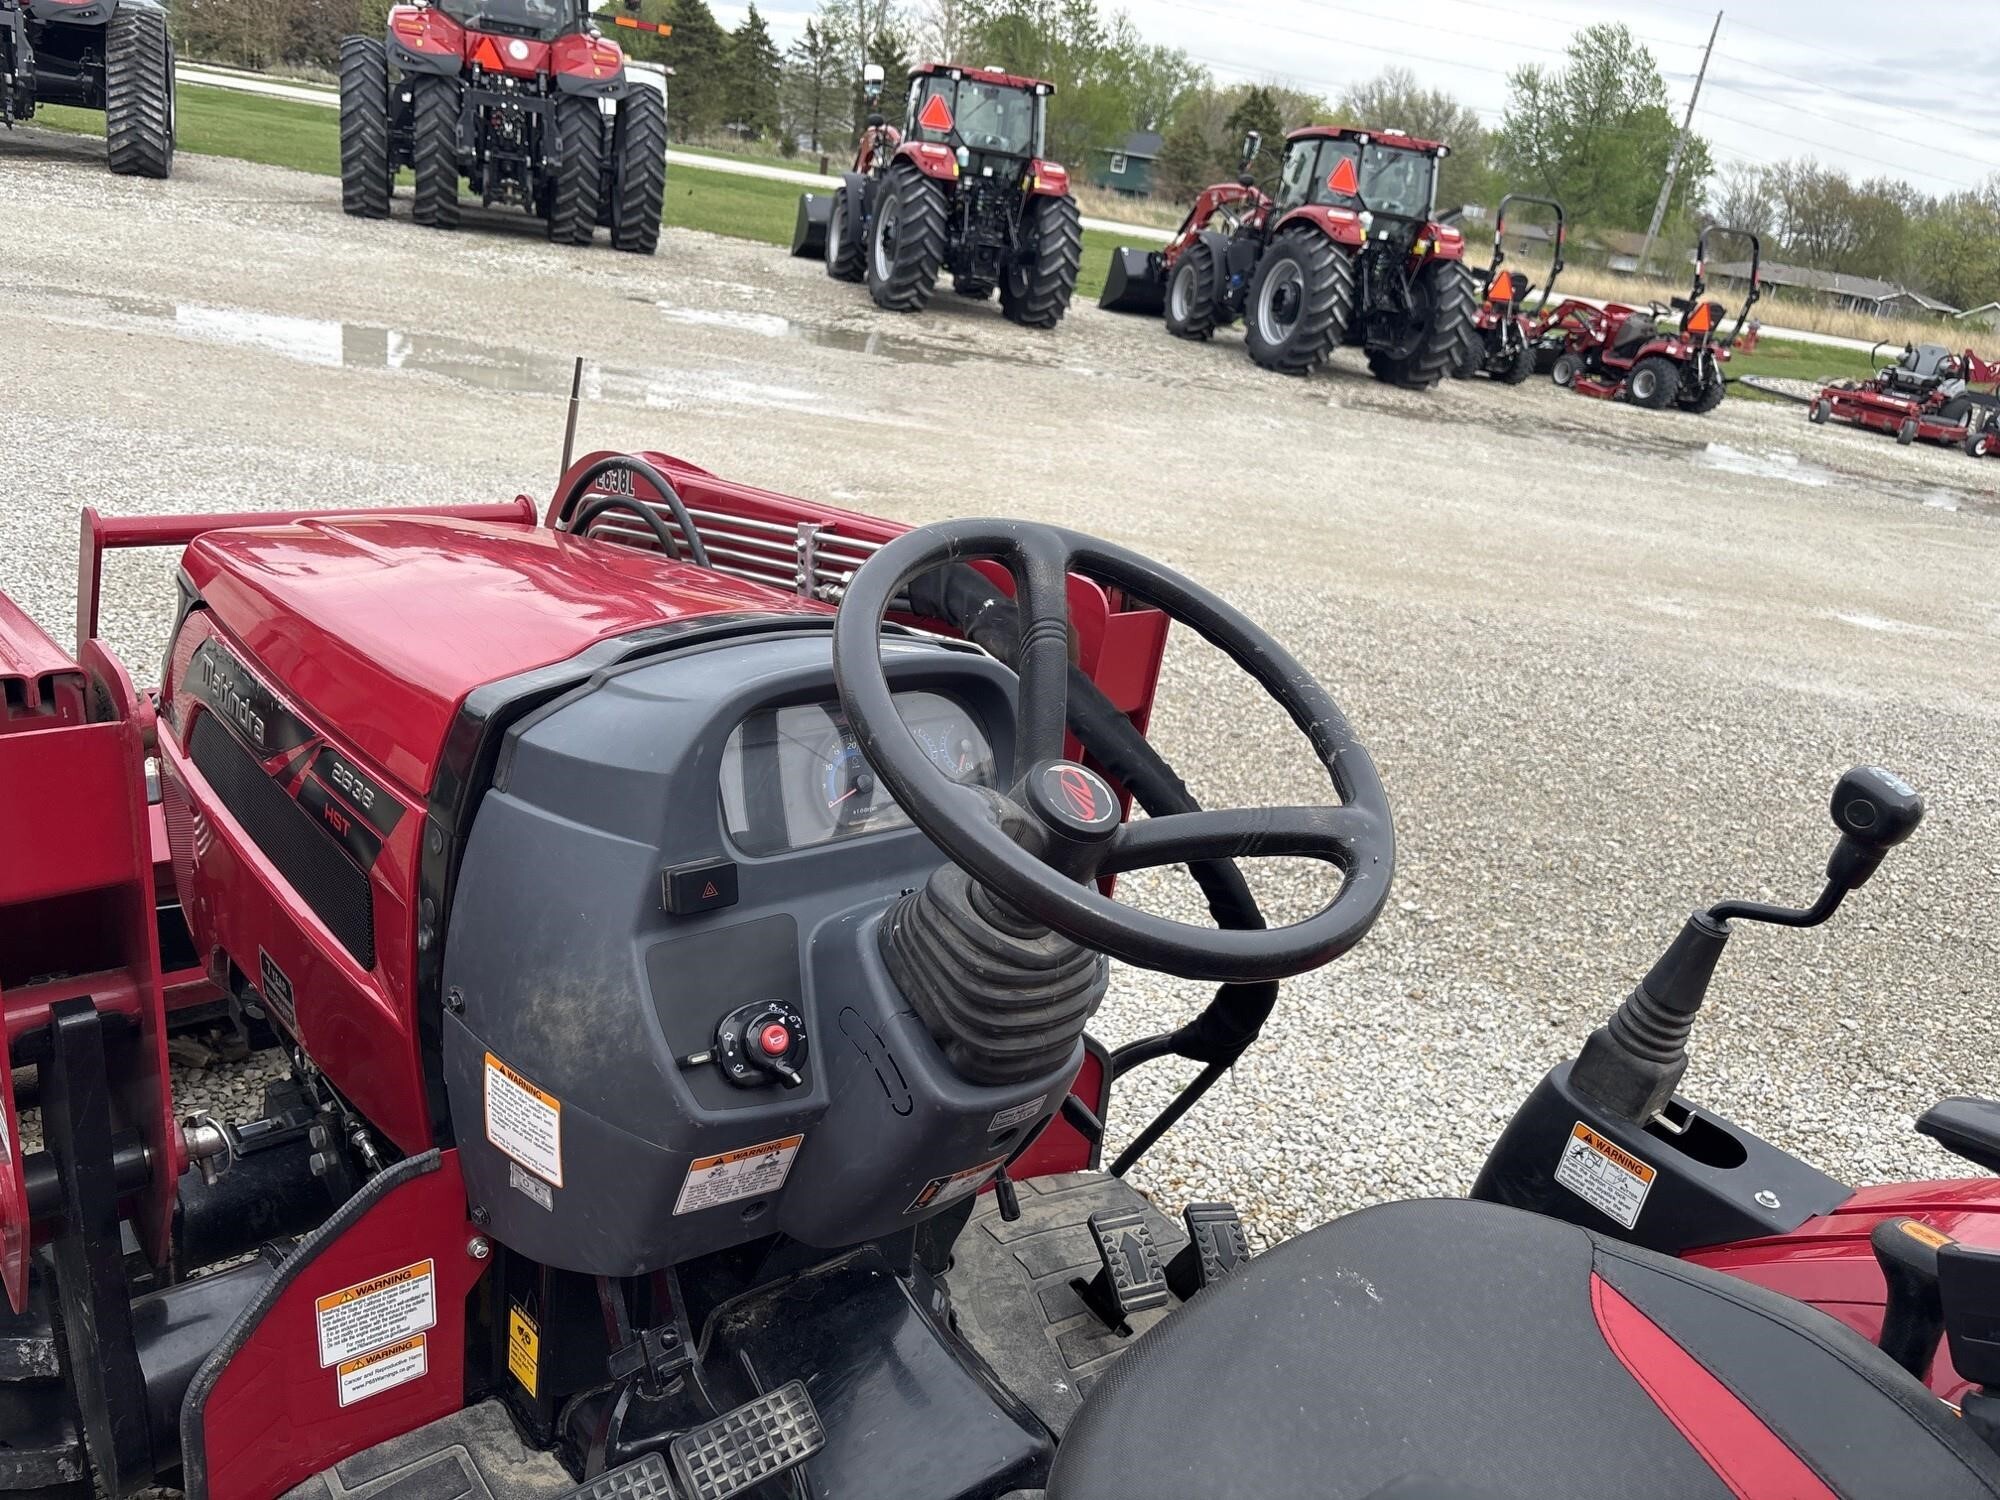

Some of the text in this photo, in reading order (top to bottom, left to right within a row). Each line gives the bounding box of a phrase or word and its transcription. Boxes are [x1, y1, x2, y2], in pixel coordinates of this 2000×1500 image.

[202, 653, 265, 745] Mahindra
[825, 763, 833, 771] 10
[331, 761, 376, 811] 2638
[324, 801, 351, 838] HST
[508, 1070, 541, 1100] WARNING
[731, 1143, 782, 1160] WARNING
[1595, 1139, 1643, 1175] WARNING
[356, 1269, 410, 1296] WARNING
[366, 1341, 412, 1364] WARNING
[344, 1374, 362, 1386] Cancer
[364, 1370, 372, 1378] and
[374, 1357, 406, 1374] Reproductive
